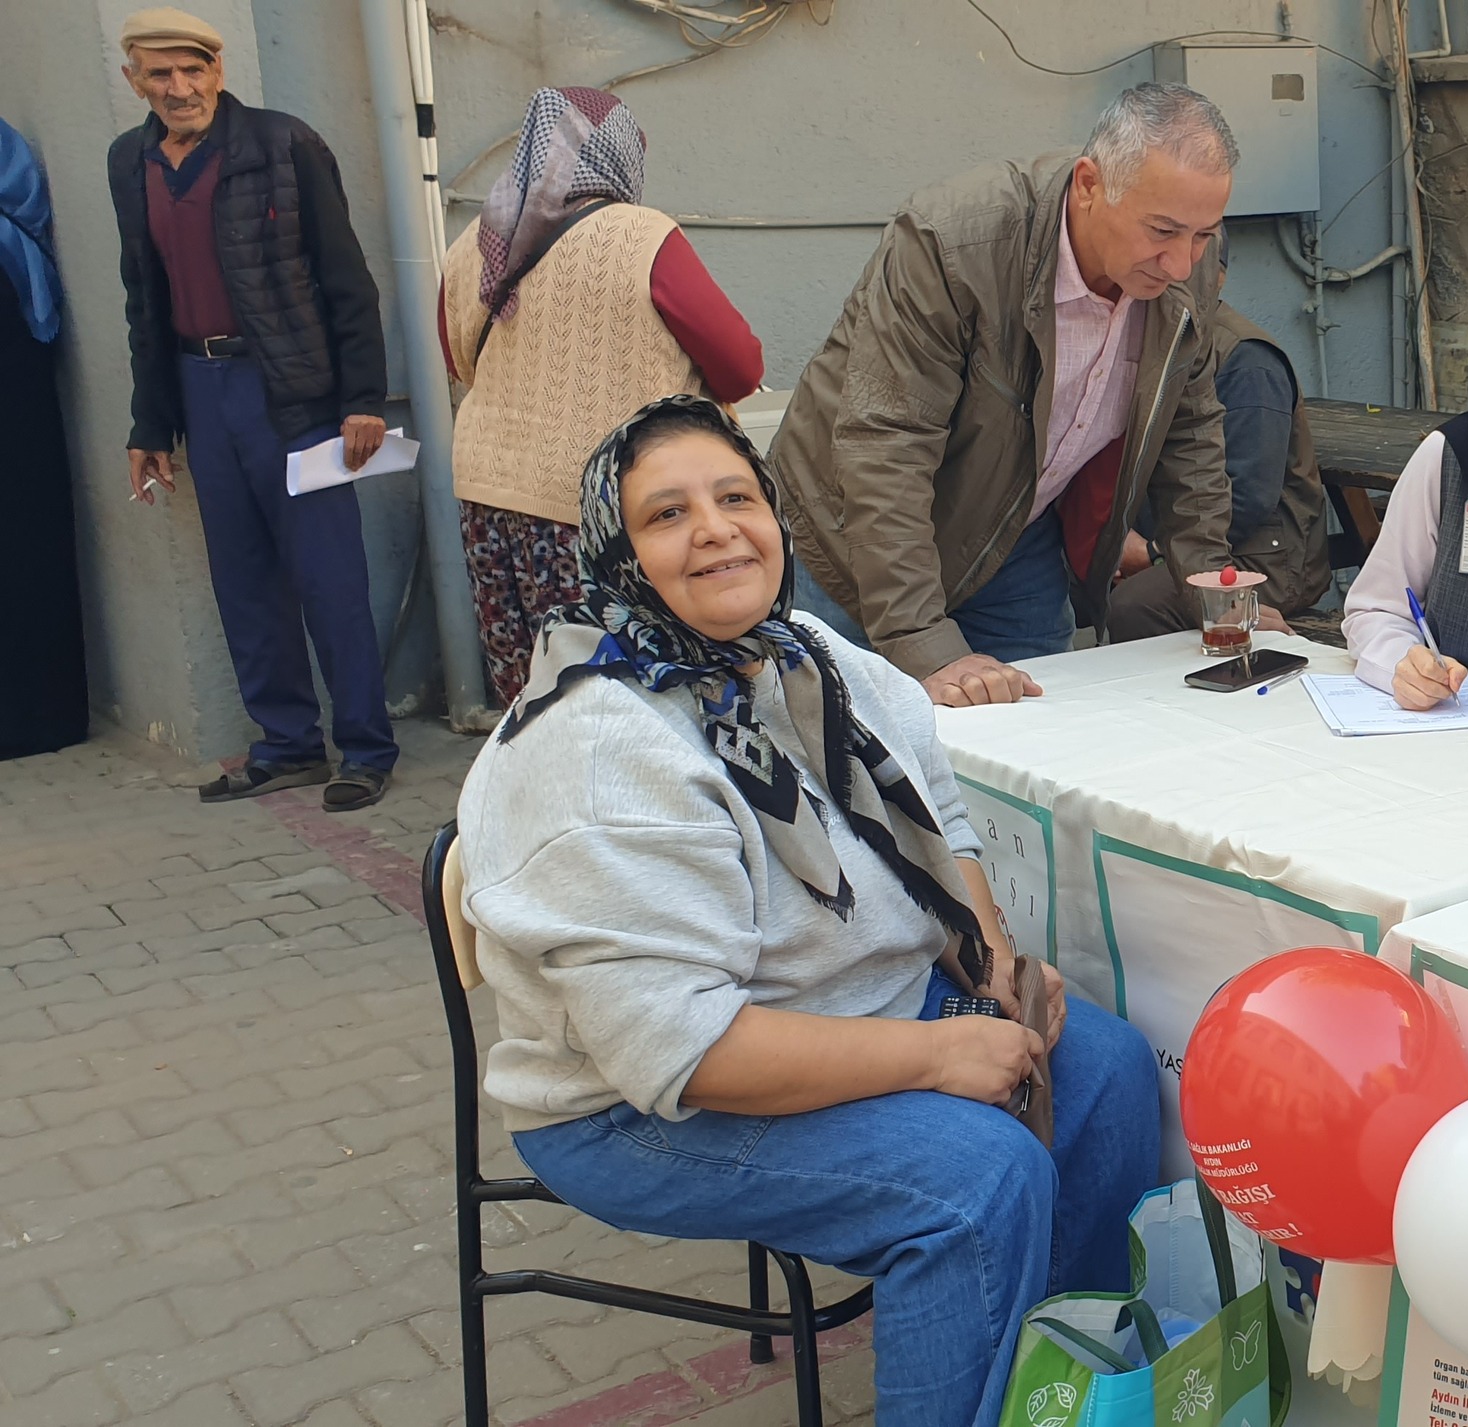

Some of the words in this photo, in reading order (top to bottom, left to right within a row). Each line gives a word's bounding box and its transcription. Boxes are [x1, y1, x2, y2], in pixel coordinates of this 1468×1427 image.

[1207, 1139, 1252, 1155] BAKANLIĞI
[1217, 1183, 1276, 1205] BAĞIŞI
[1434, 1358, 1459, 1374] Organ
[1433, 1371, 1449, 1383] tüm
[1432, 1388, 1459, 1406] Aydın
[1431, 1401, 1456, 1418] İzleme
[1458, 1412, 1468, 1422] ve
